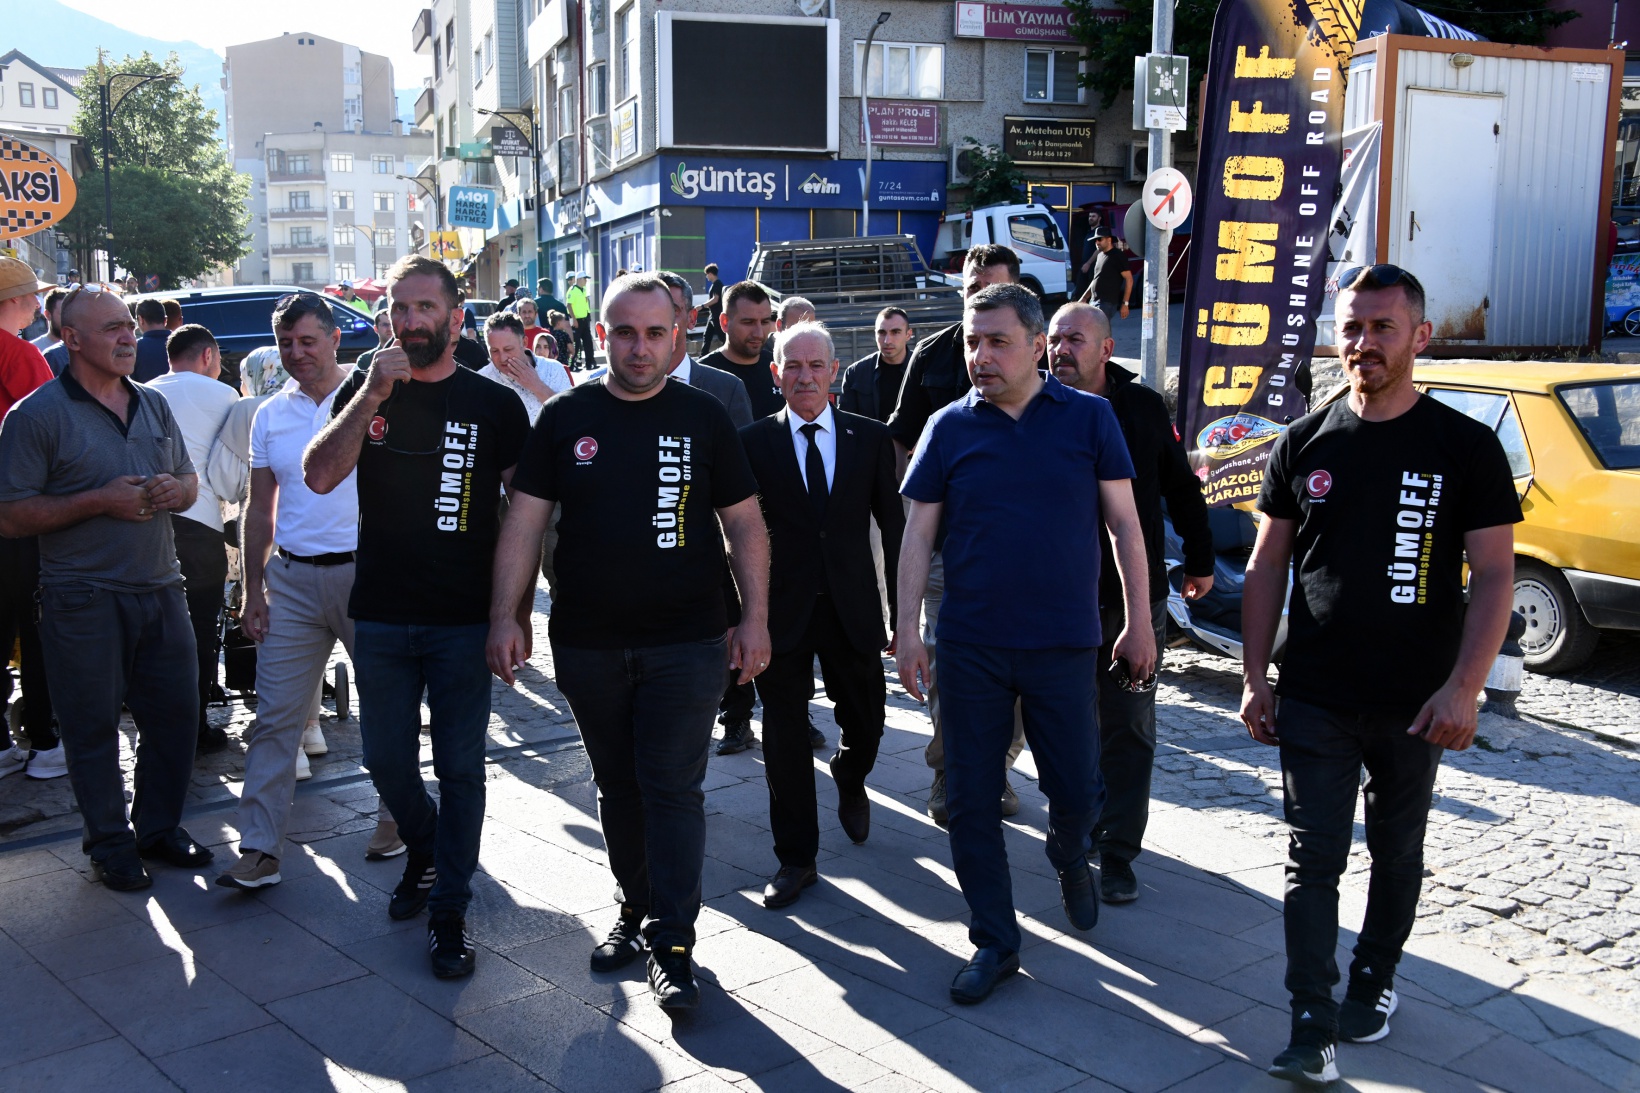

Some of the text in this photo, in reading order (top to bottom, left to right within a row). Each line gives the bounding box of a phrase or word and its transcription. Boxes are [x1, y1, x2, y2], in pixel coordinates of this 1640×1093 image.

[986, 5, 1015, 25] İLİM
[1015, 10, 1065, 26] YAYMA
[1015, 28, 1067, 37] GÜMÜŞHANE
[868, 106, 931, 118] PLAN PROJE
[1010, 125, 1091, 138] Av. Metehan UTUŞ
[1045, 140, 1083, 148] Danışmanlık
[681, 165, 776, 200] güntaş
[802, 177, 841, 194] evim
[878, 181, 902, 190] 7/24
[455, 200, 487, 210] HARCA
[878, 193, 930, 202] guntasavm.com
[455, 207, 487, 217] HARCA
[1197, 45, 1296, 407] GÜMOFF
[1267, 67, 1332, 407] GÜMÜŞHANE OFF ROAD
[434, 420, 467, 532] GÜMOFF
[459, 423, 478, 532] Gümüşhane Off Road
[652, 435, 681, 549] GÜMOFF
[677, 437, 692, 547] Gümüşhane Off Road
[1387, 471, 1429, 604] GÜMOFF
[1417, 474, 1443, 604] Gümüşhane Off Road
